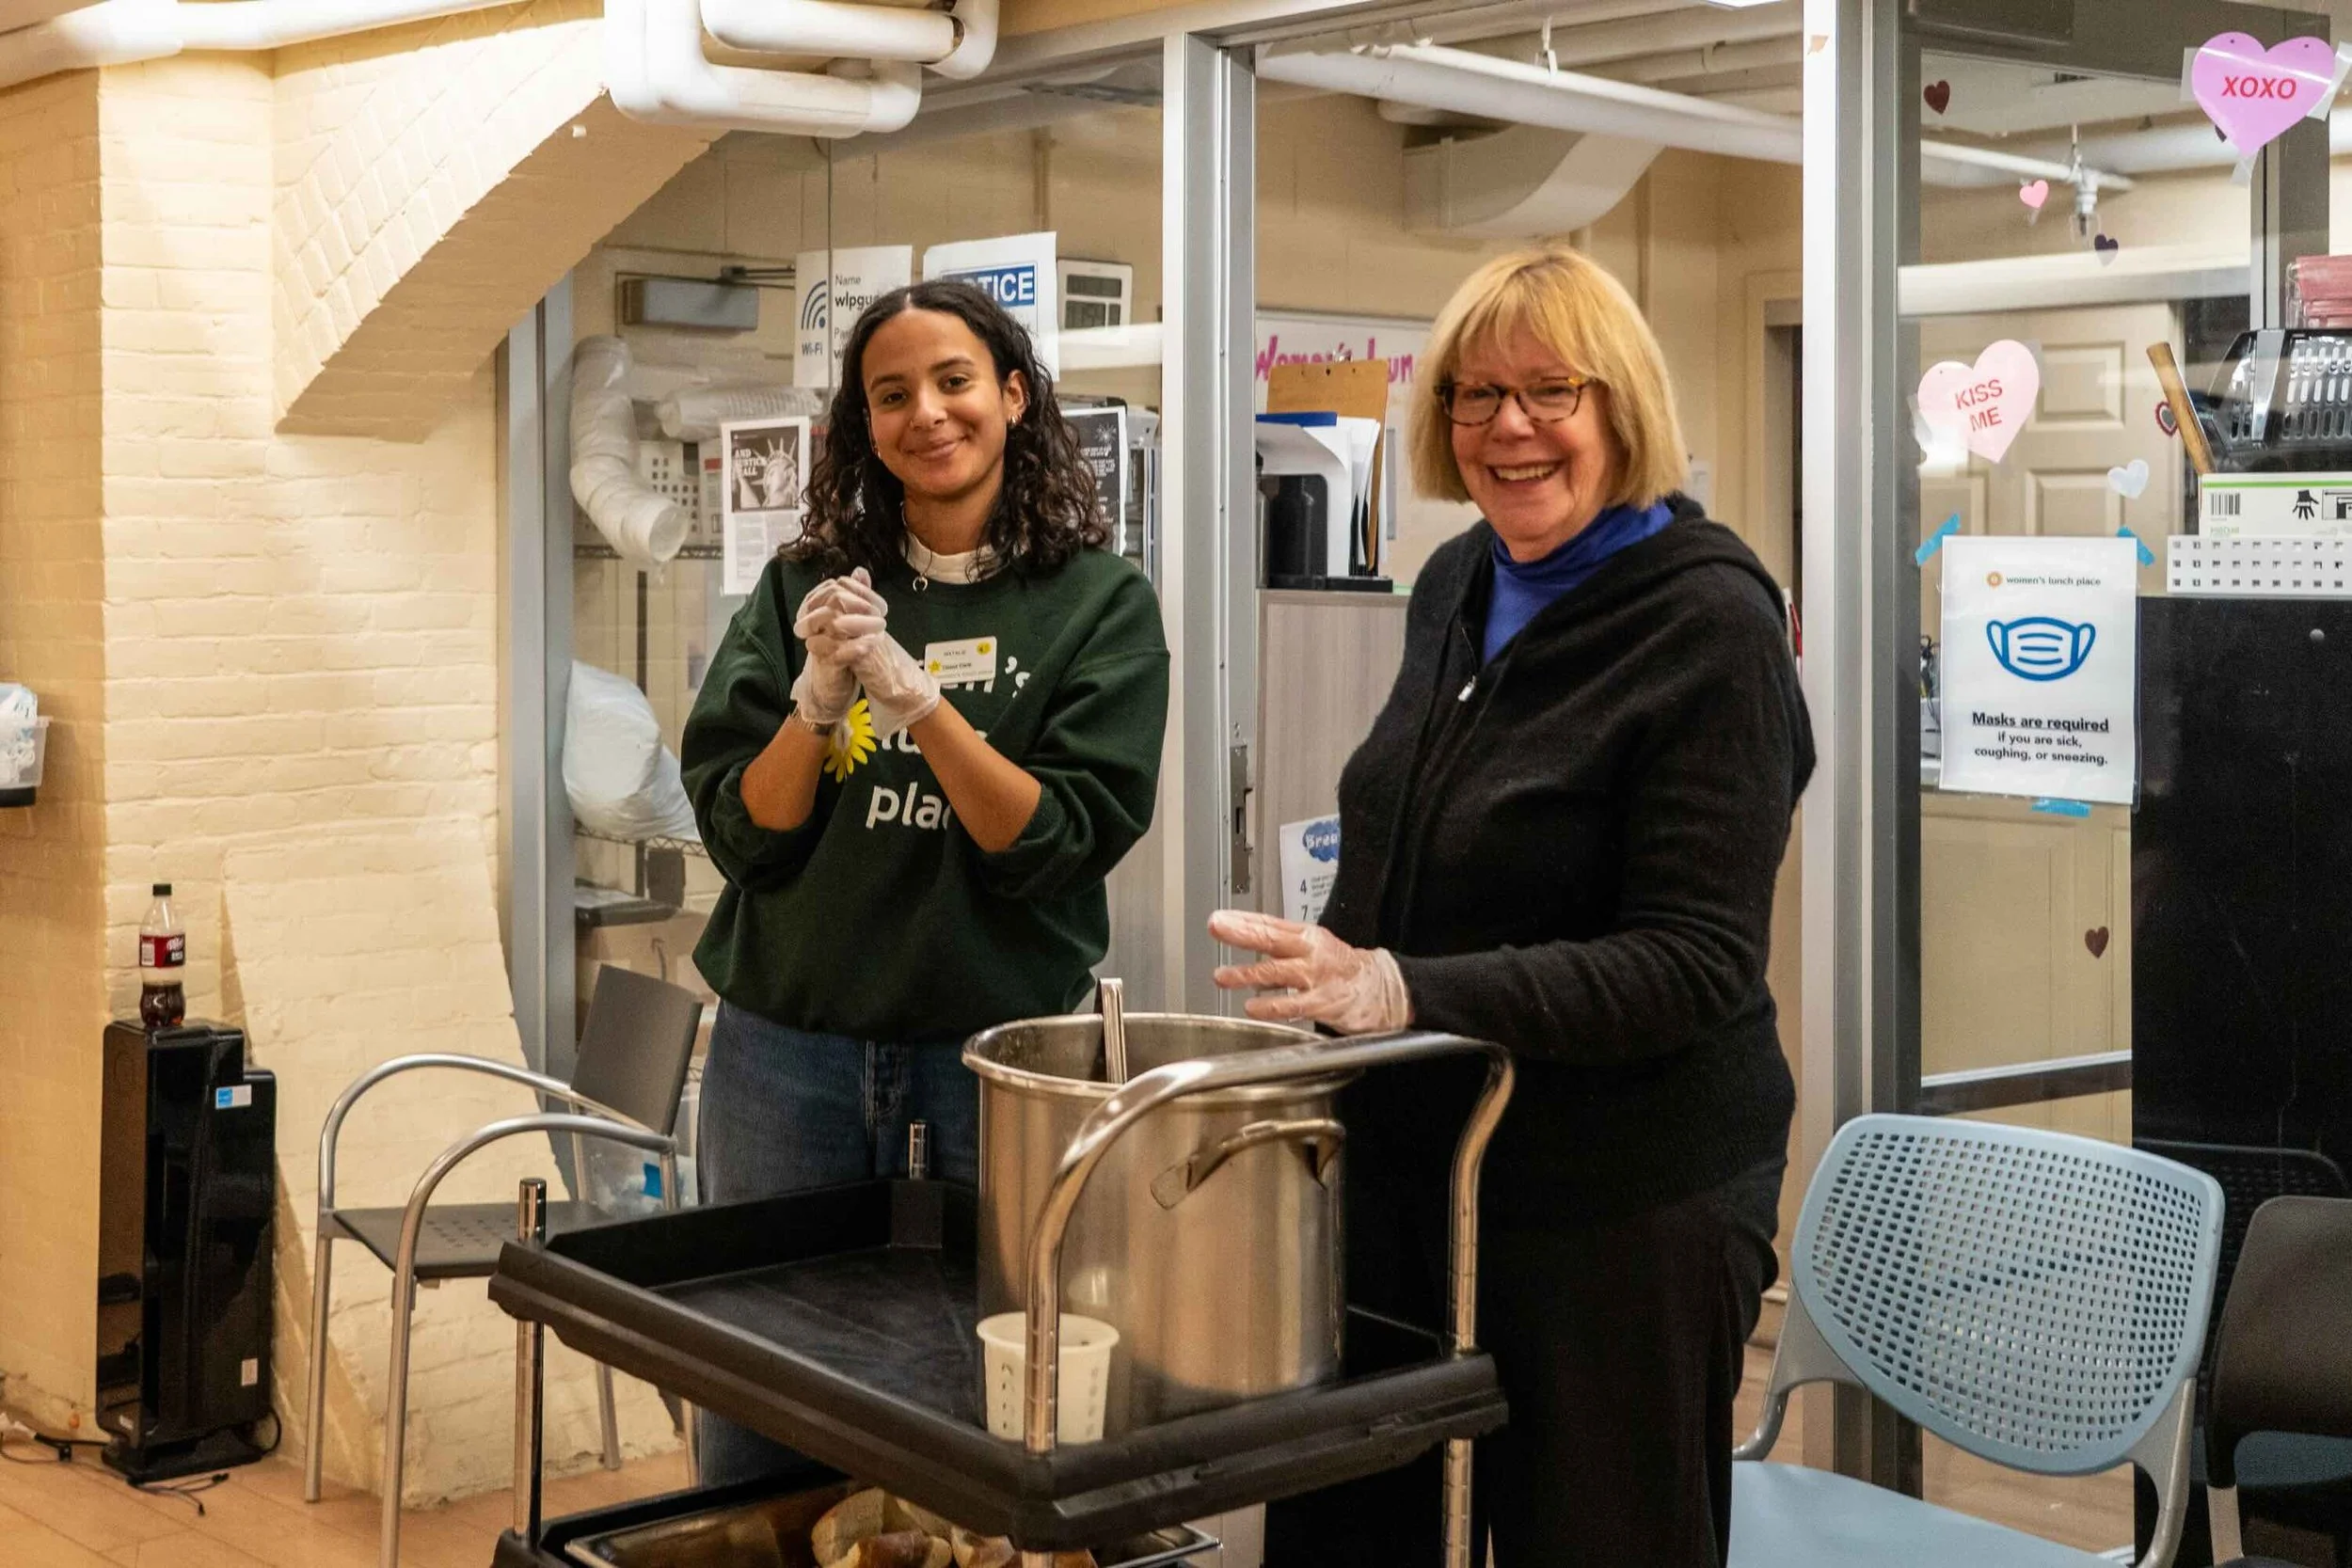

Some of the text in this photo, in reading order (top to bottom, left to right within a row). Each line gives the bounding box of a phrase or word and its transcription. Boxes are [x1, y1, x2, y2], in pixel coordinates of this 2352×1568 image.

[2221, 75, 2297, 101] XOXO
[835, 276, 861, 285] Name
[961, 269, 1035, 303] TICE
[834, 292, 878, 311] wlpgu
[802, 342, 823, 356] Wi-Fi
[1955, 379, 2003, 411] KISS
[1969, 406, 2003, 433] ME
[2007, 576, 2102, 587] women's lunch place
[1972, 712, 2109, 732] Masks are required
[2010, 736, 2030, 746] you
[2034, 736, 2053, 746] are
[2057, 736, 2082, 749] sick,
[1975, 746, 2031, 761] coughing,
[2052, 752, 2108, 767] sneezing.
[1300, 879, 1307, 894] 4
